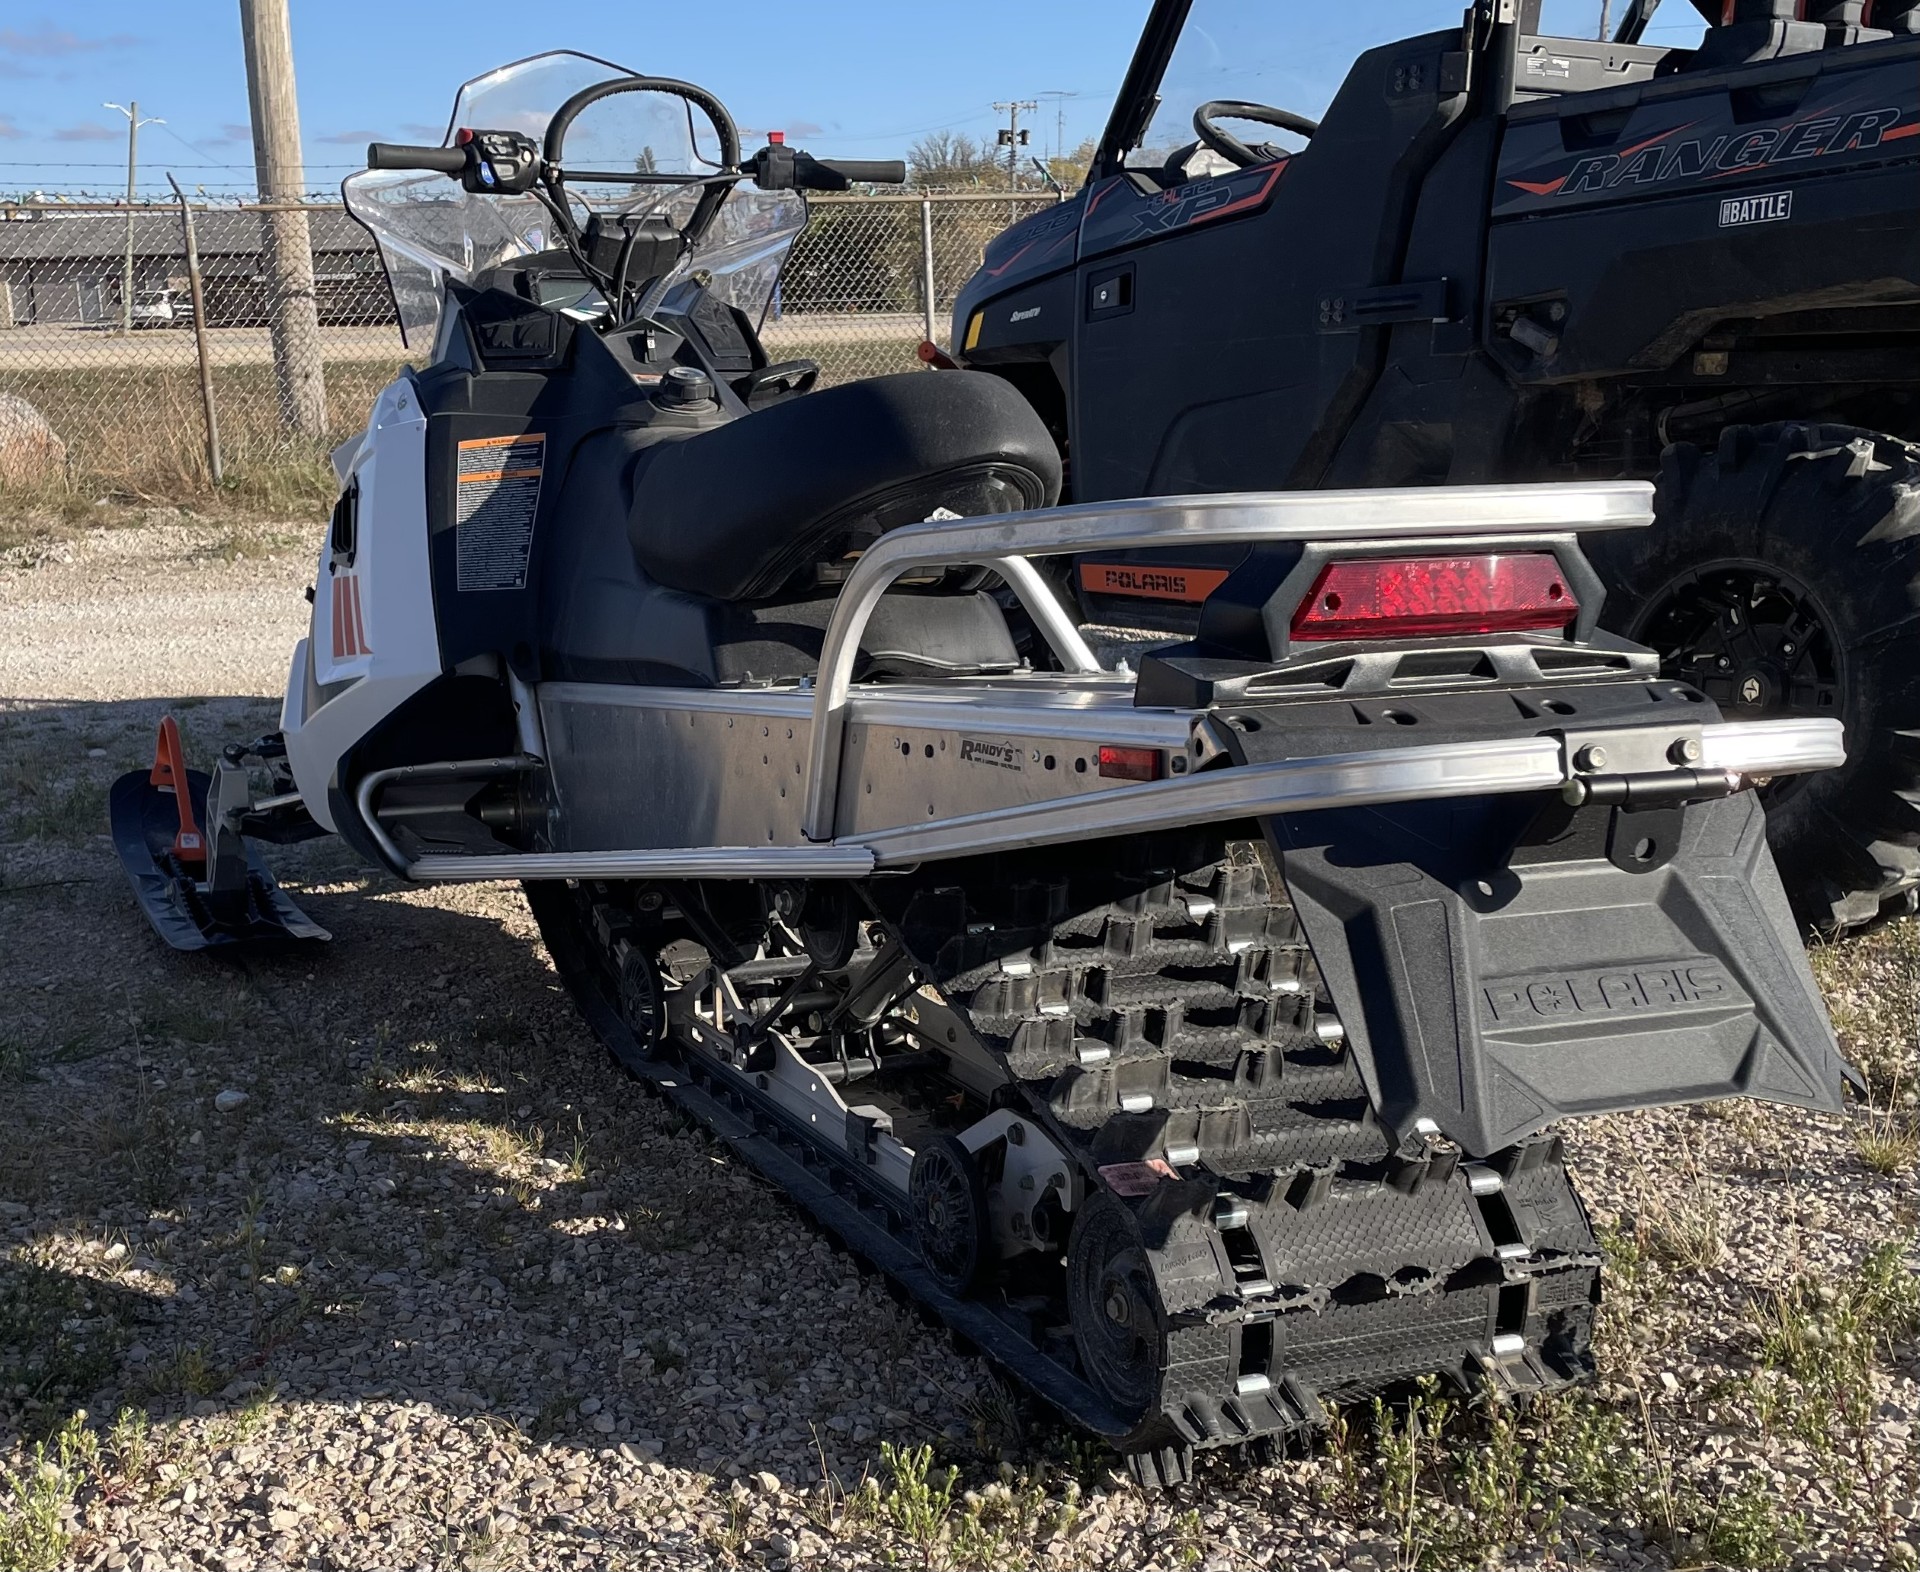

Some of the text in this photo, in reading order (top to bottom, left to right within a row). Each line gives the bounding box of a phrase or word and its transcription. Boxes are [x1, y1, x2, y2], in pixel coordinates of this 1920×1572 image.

[1556, 108, 1901, 196] RANGER
[1114, 185, 1233, 245] XP
[1729, 195, 1789, 223] BATTLE
[1105, 570, 1186, 594] POLARIS
[960, 739, 1014, 763] RANDY'S
[1484, 966, 1733, 1021] POLARIS
